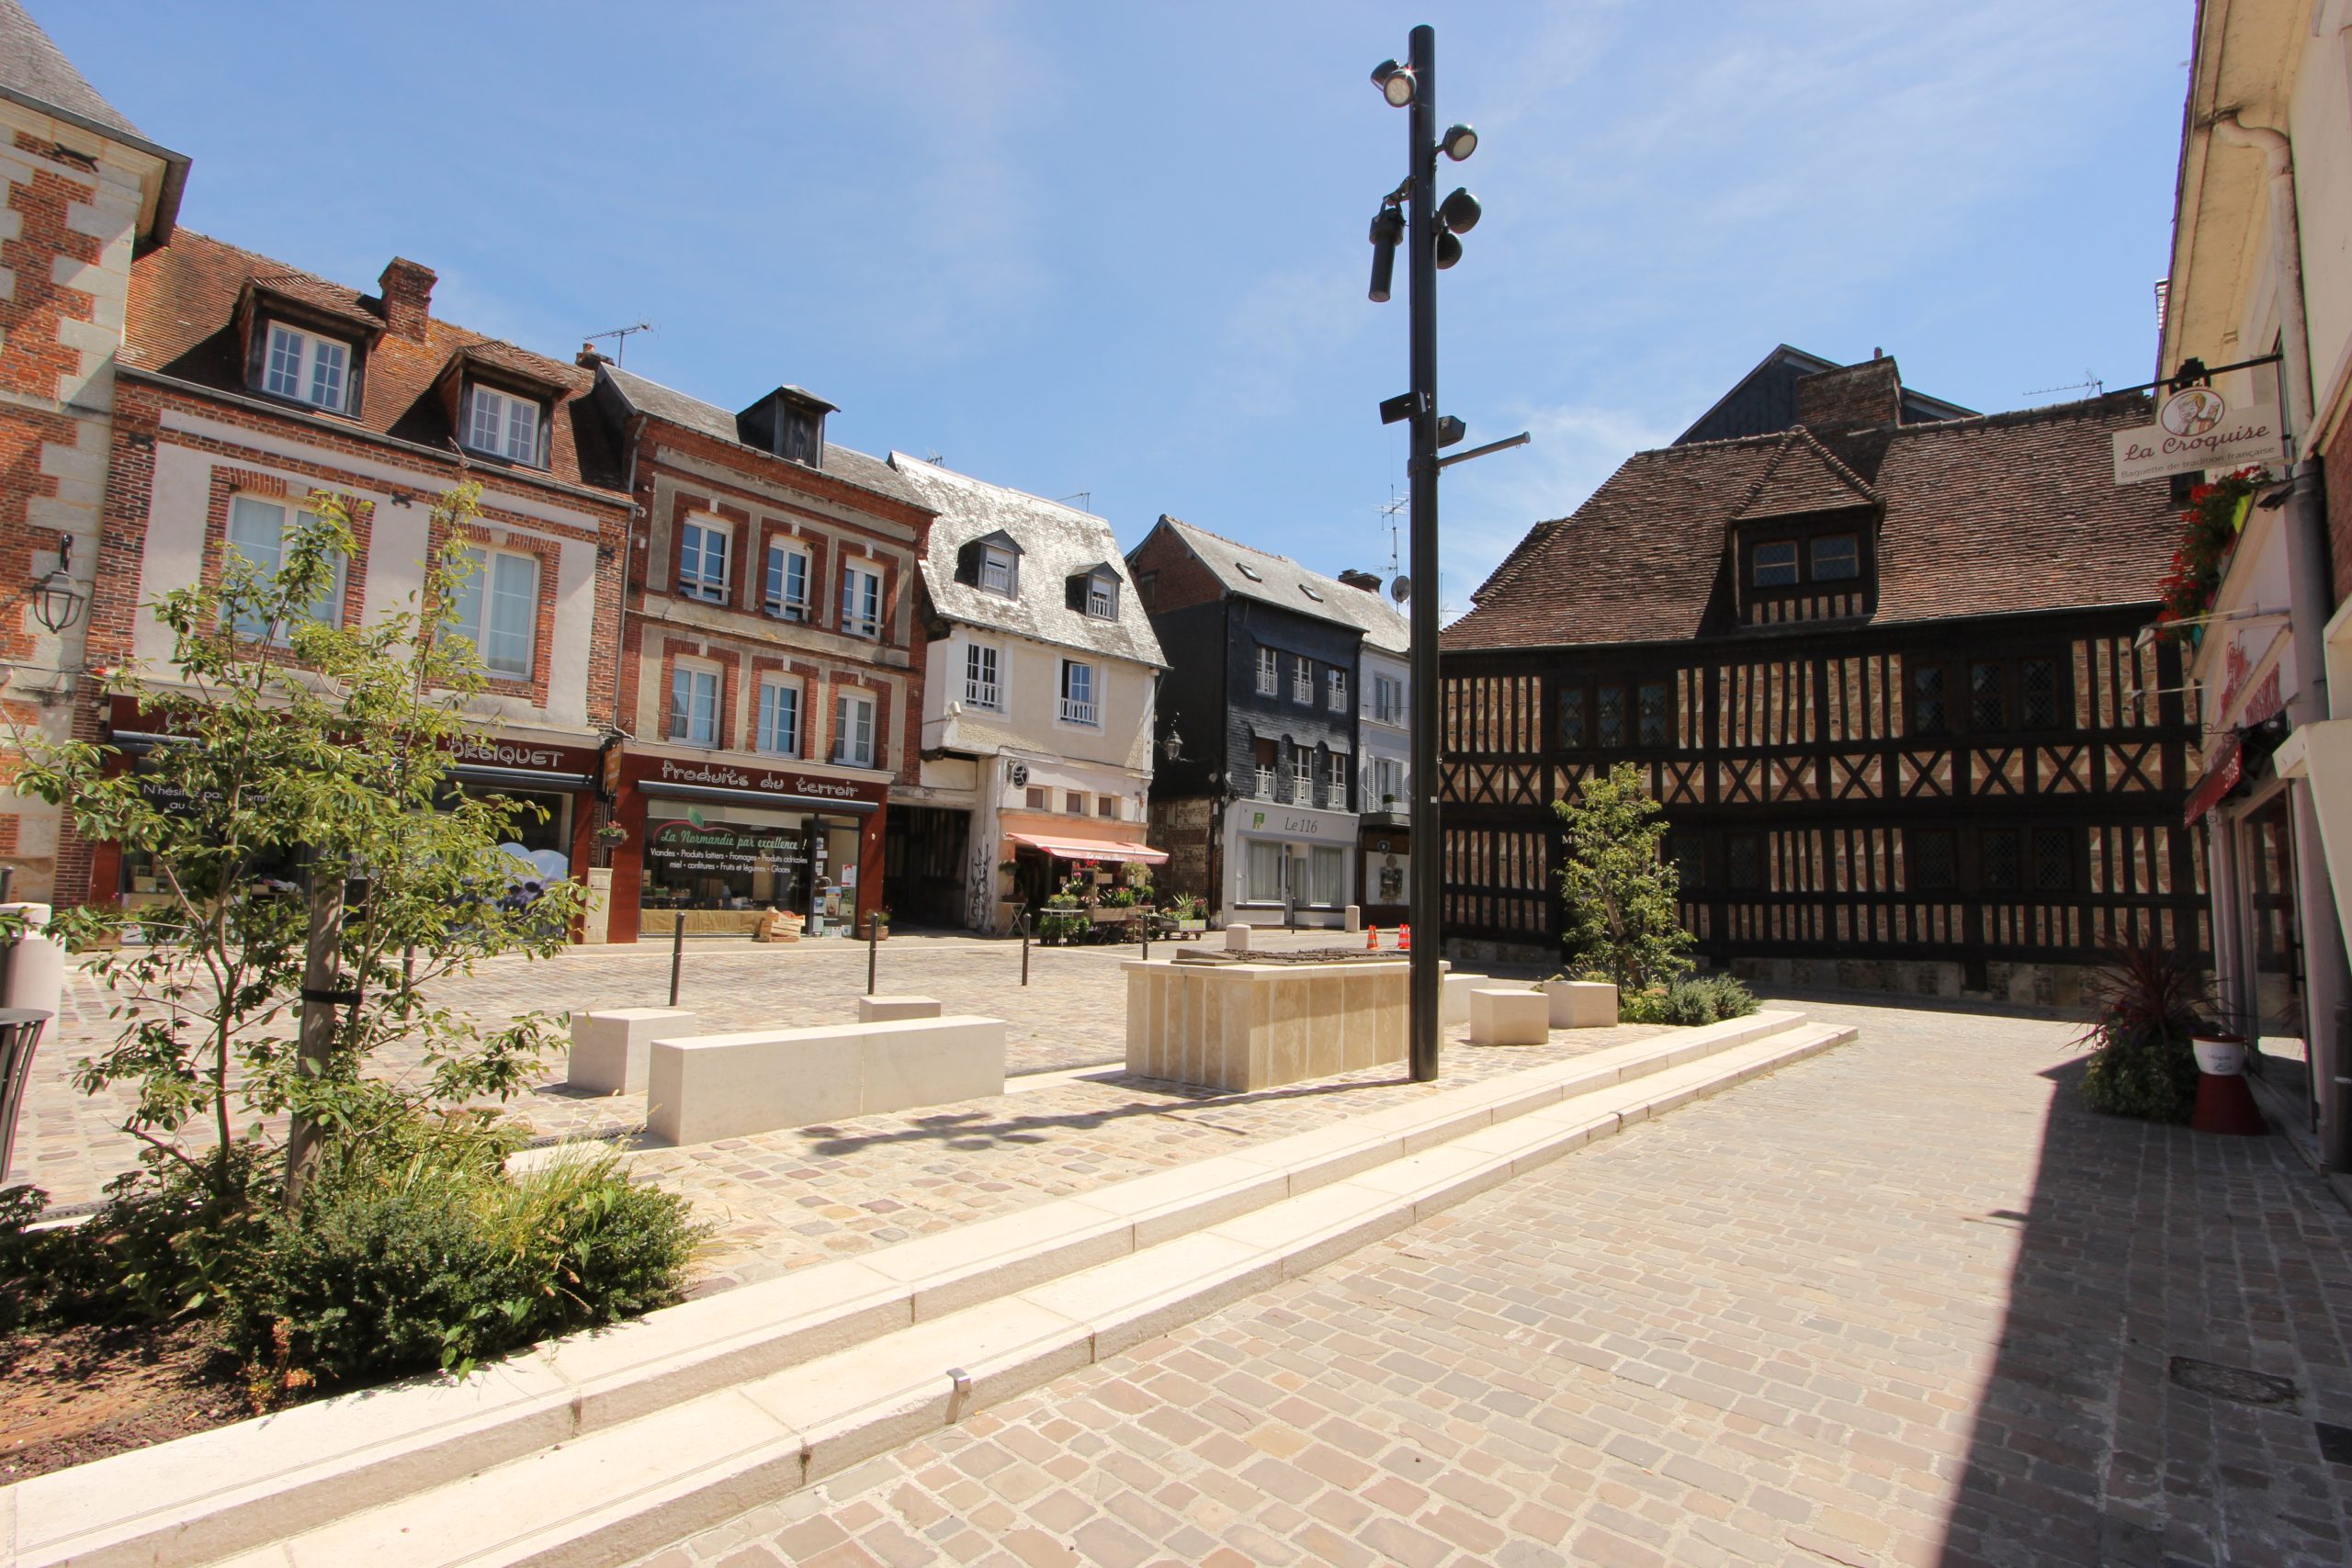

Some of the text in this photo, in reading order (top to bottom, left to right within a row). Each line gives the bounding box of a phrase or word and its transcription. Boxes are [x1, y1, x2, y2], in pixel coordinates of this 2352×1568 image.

[2124, 425, 2270, 462] La Croquise
[2121, 446, 2275, 478] Baguette de tradition française
[446, 739, 564, 767] 'ORBIQUET
[662, 760, 859, 797] Produits du terroir
[1285, 817, 1317, 833] Le 116
[661, 829, 676, 842] La
[681, 830, 734, 846] Normandie
[737, 837, 753, 850] par
[758, 837, 798, 850] excellence
[650, 848, 675, 857] Viandes
[681, 850, 704, 859] Produits
[706, 851, 725, 860] laitiers
[729, 852, 757, 862] Fromages
[762, 853, 783, 863] Produits
[669, 861, 683, 869] miel
[687, 861, 716, 870] confitures
[720, 862, 735, 871] Fruits
[743, 863, 766, 874] légumes
[772, 864, 791, 874] Glaces
